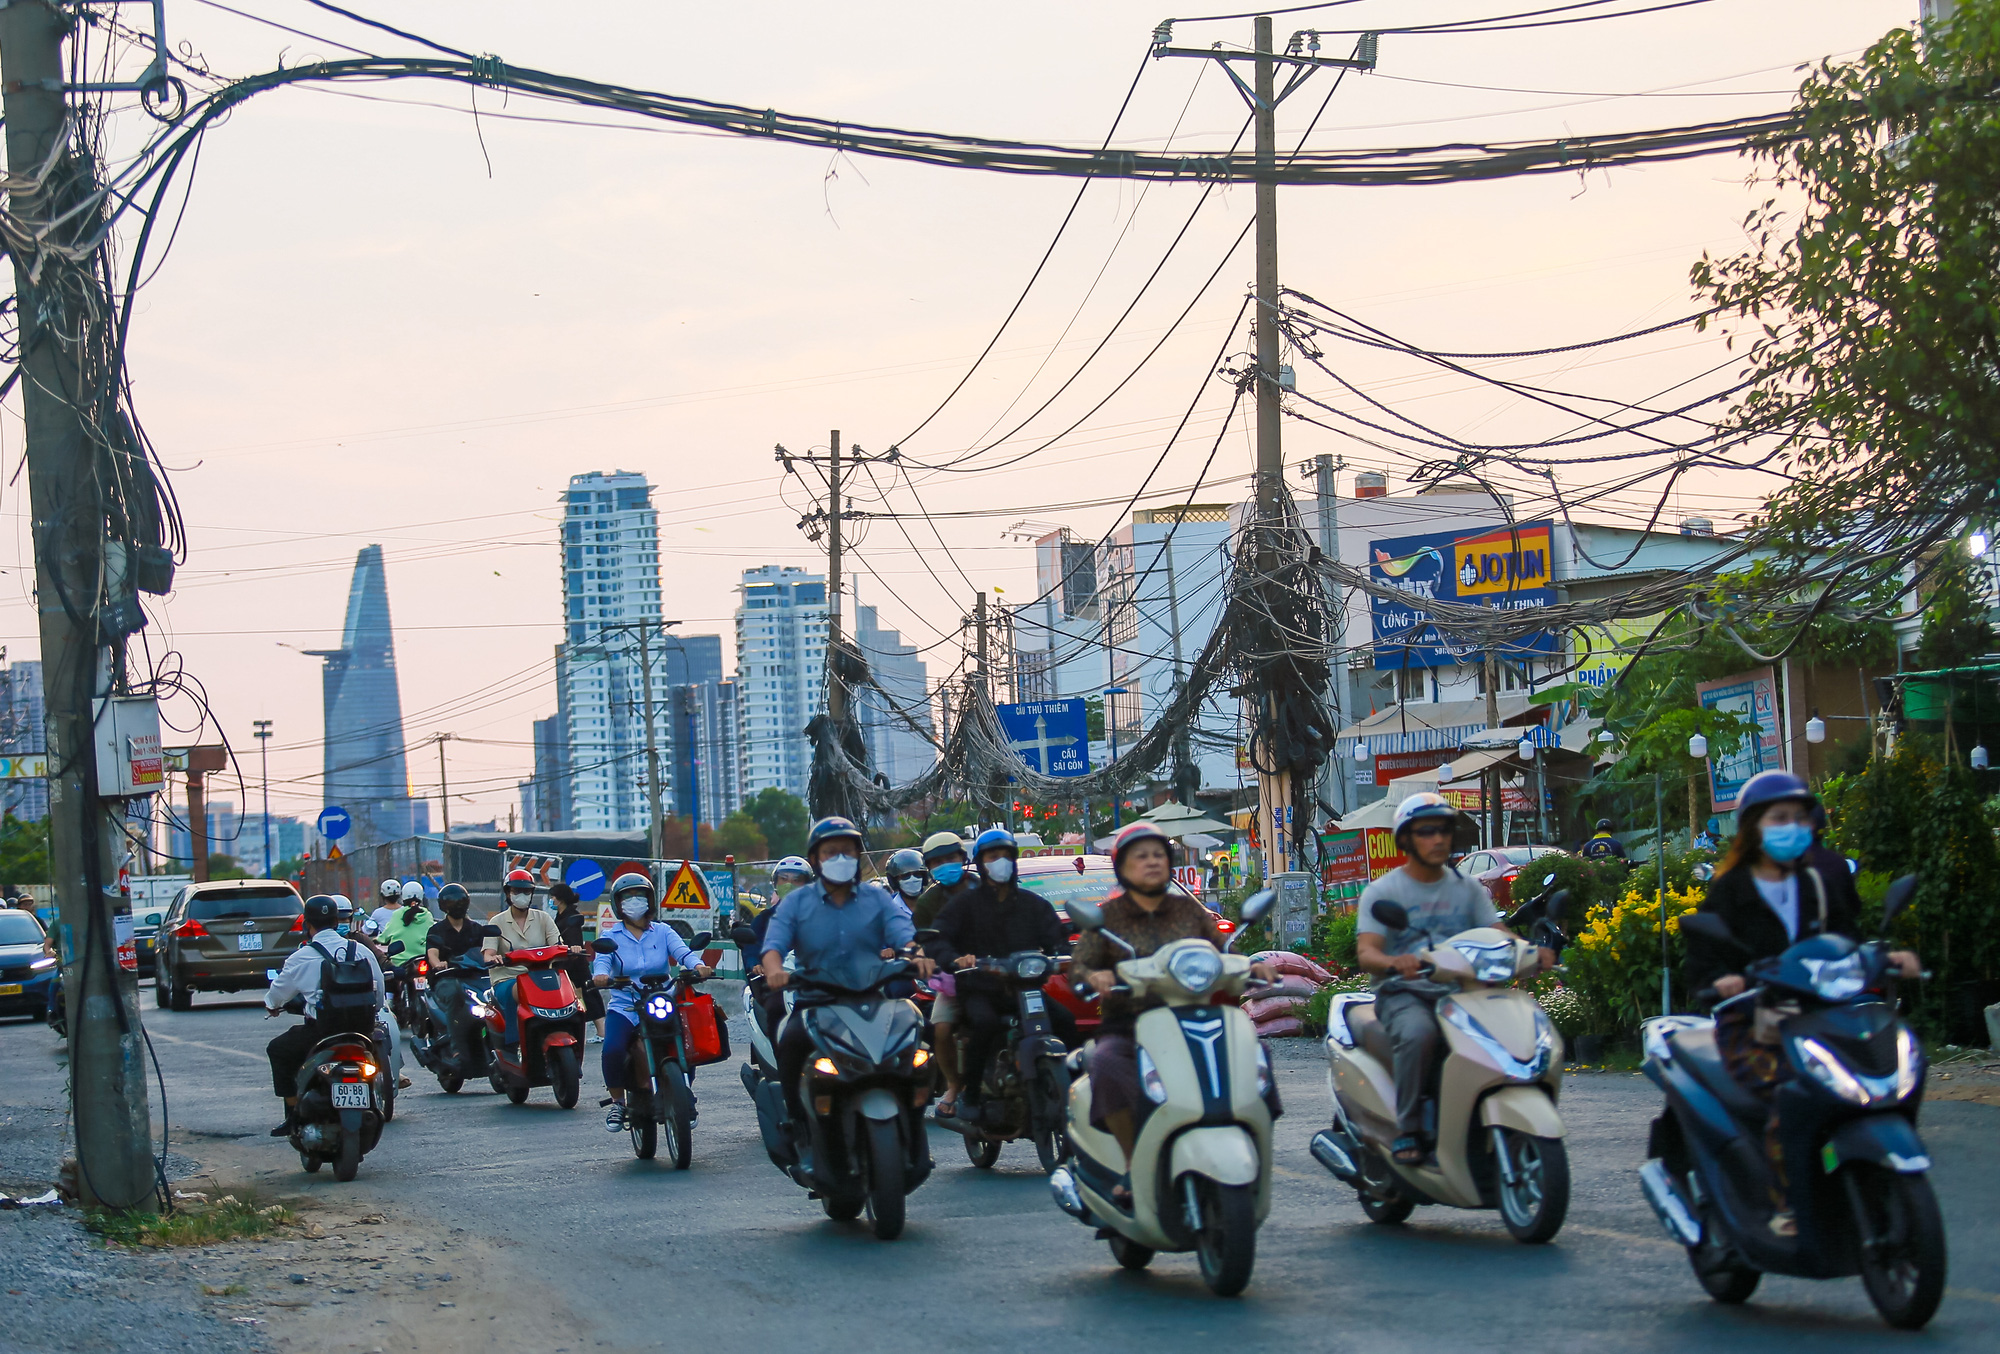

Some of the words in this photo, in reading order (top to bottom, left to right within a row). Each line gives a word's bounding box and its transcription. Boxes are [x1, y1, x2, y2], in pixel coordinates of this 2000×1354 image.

[1478, 549, 1545, 584] JOTUN
[1377, 577, 1435, 605] Dlux
[1382, 610, 1408, 628] CÔNG
[1044, 702, 1069, 713] THIÊM
[1053, 760, 1066, 771] SÀI
[1067, 759, 1083, 770] GÒN
[1368, 831, 1398, 859] CƠM
[338, 1085, 363, 1095] 60-B8
[336, 1096, 367, 1106] 274.34
